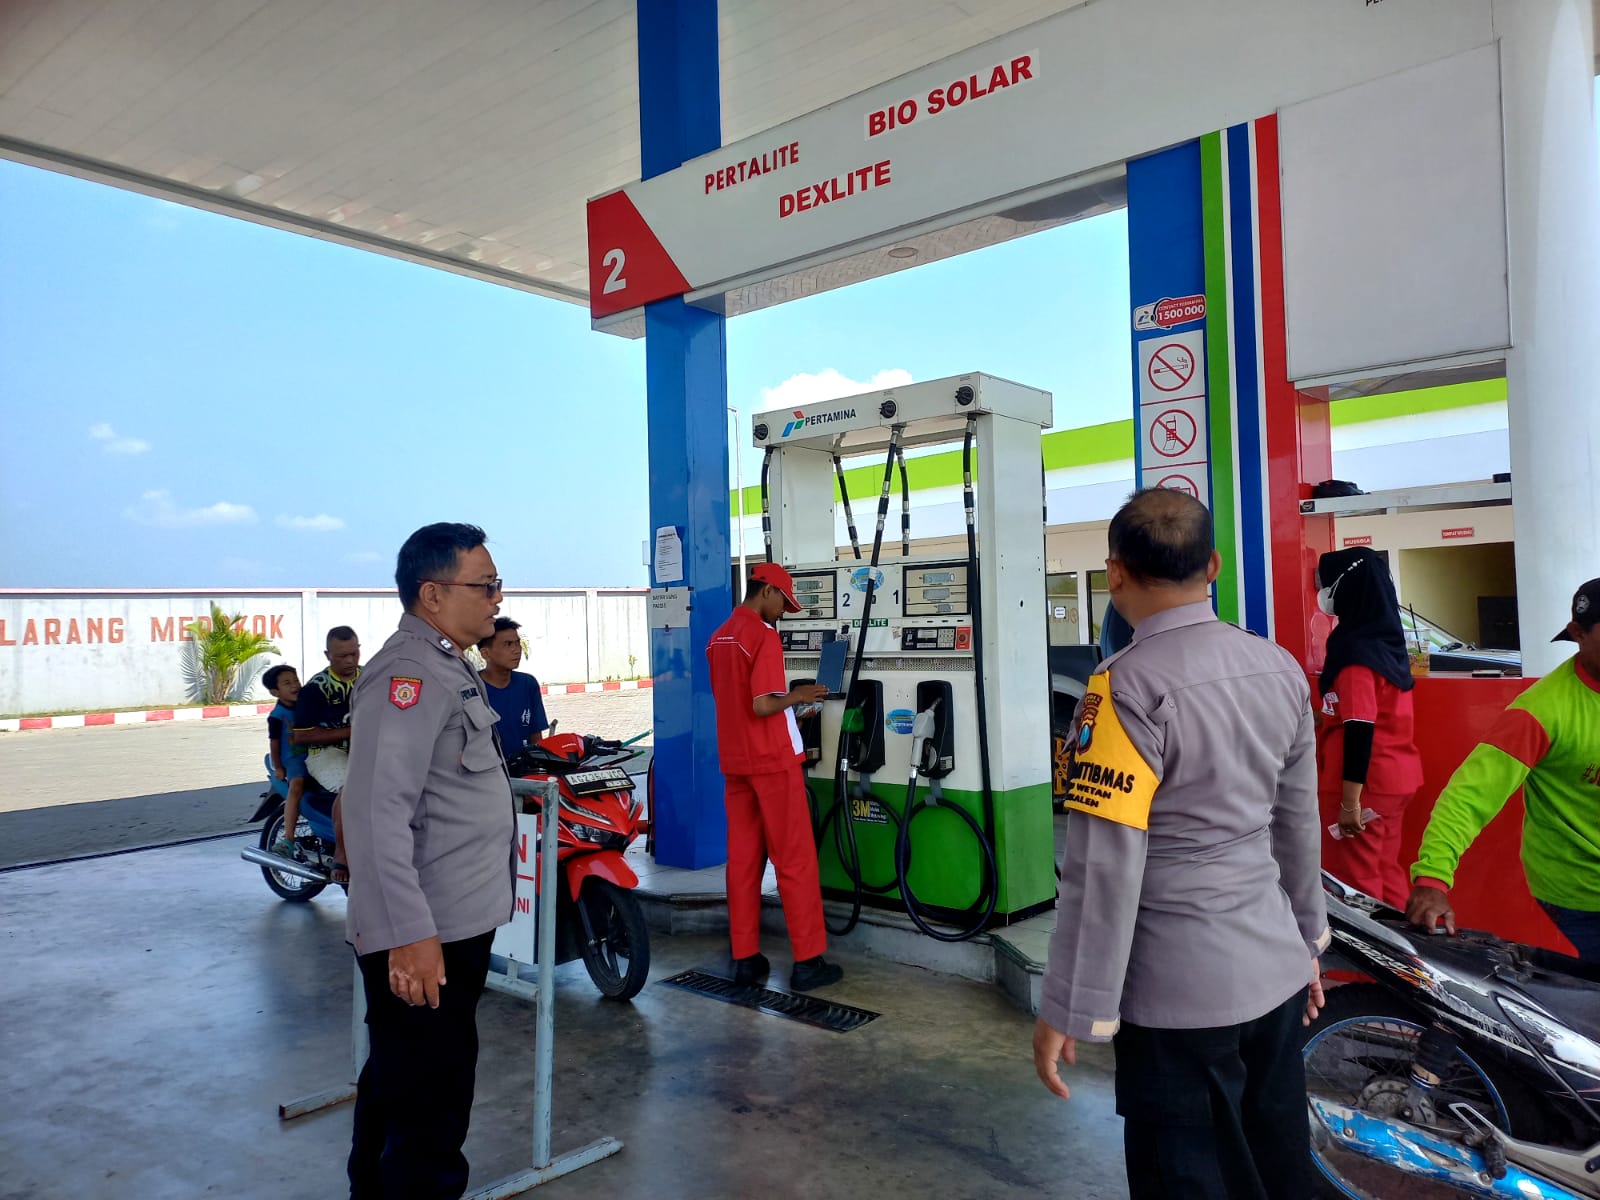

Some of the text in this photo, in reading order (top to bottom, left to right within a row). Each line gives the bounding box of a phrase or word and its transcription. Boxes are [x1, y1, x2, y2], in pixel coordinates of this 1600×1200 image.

[868, 54, 1034, 139] BIO SOLAR
[704, 141, 801, 195] PERTALITE
[778, 160, 892, 219] DEXLITE
[602, 248, 628, 295] 2
[804, 408, 857, 427] PERTAMINA
[842, 592, 851, 607] 2
[893, 589, 899, 605] 1
[0, 617, 125, 646] LARANG
[1076, 783, 1112, 800] WETAN
[852, 799, 870, 817] 3M
